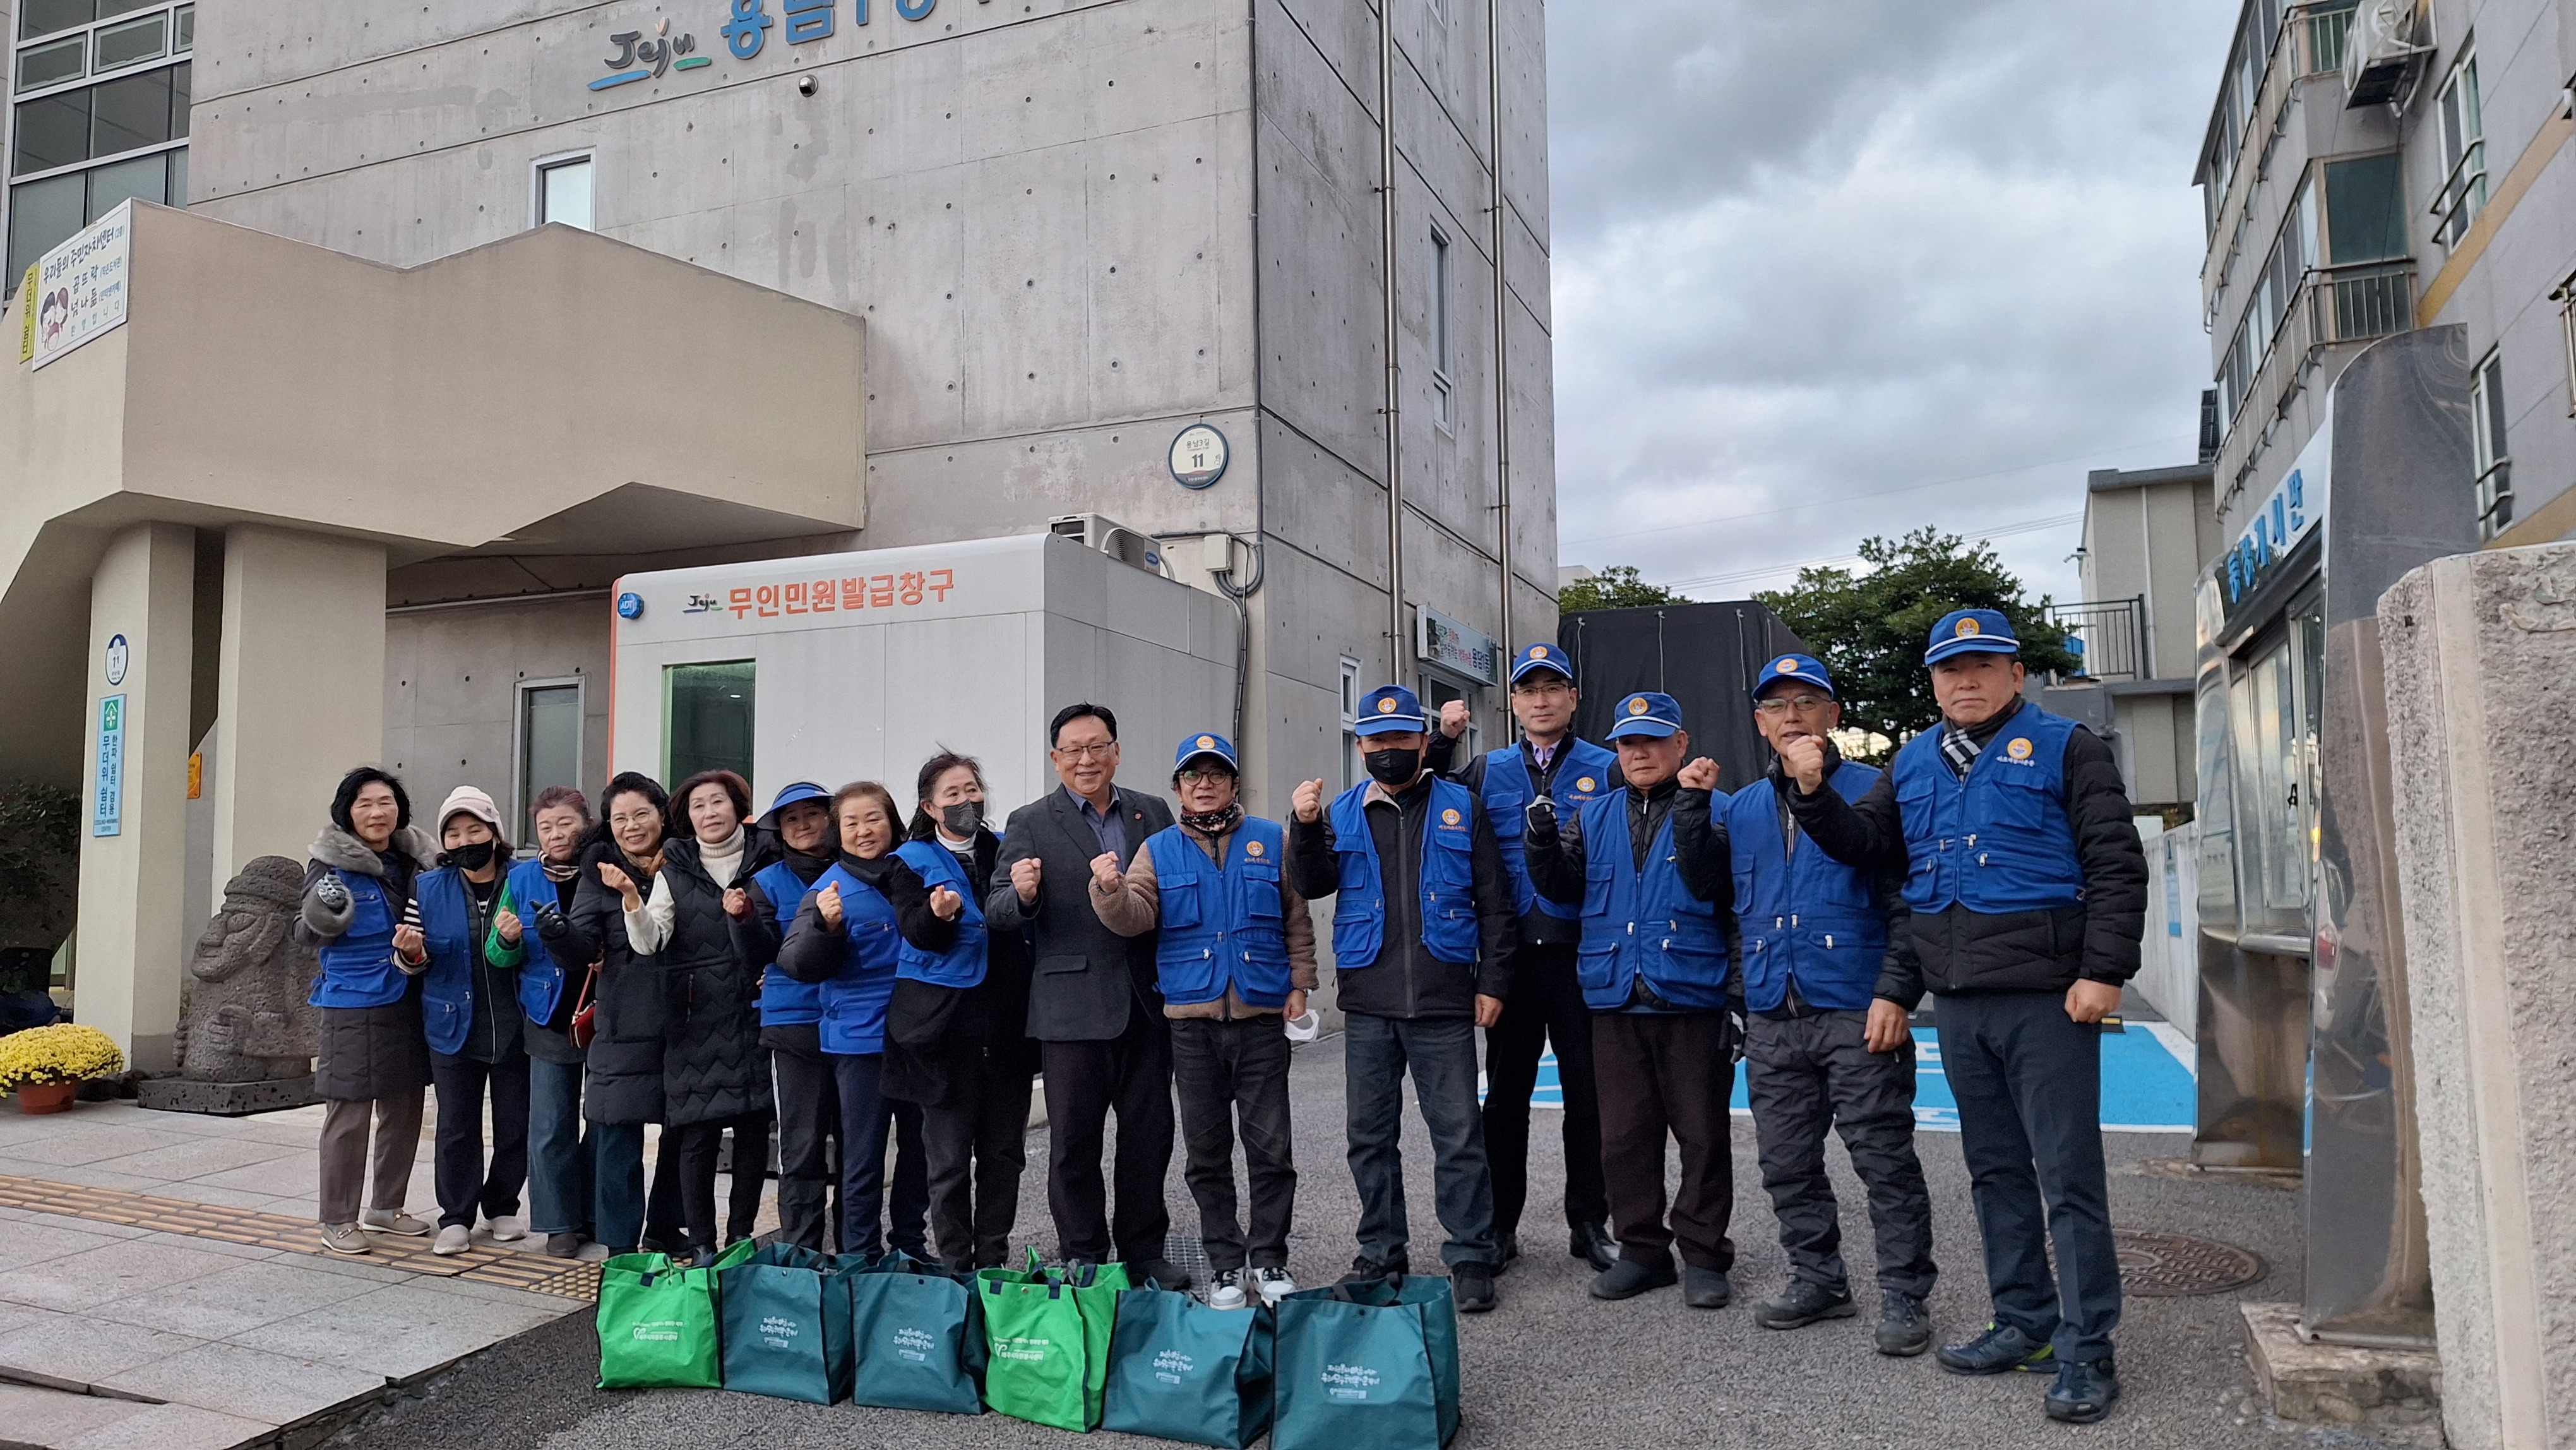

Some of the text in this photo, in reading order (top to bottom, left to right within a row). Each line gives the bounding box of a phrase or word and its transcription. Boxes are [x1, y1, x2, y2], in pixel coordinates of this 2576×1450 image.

[604, 17, 695, 78] Jeju
[44, 253, 69, 285] 우리들의
[1192, 453, 1203, 468] 11
[620, 600, 634, 610] ADT
[687, 594, 718, 611] Jeju
[728, 568, 955, 620] 무인민원발급창구
[100, 735, 110, 817] 무더위 쉼터
